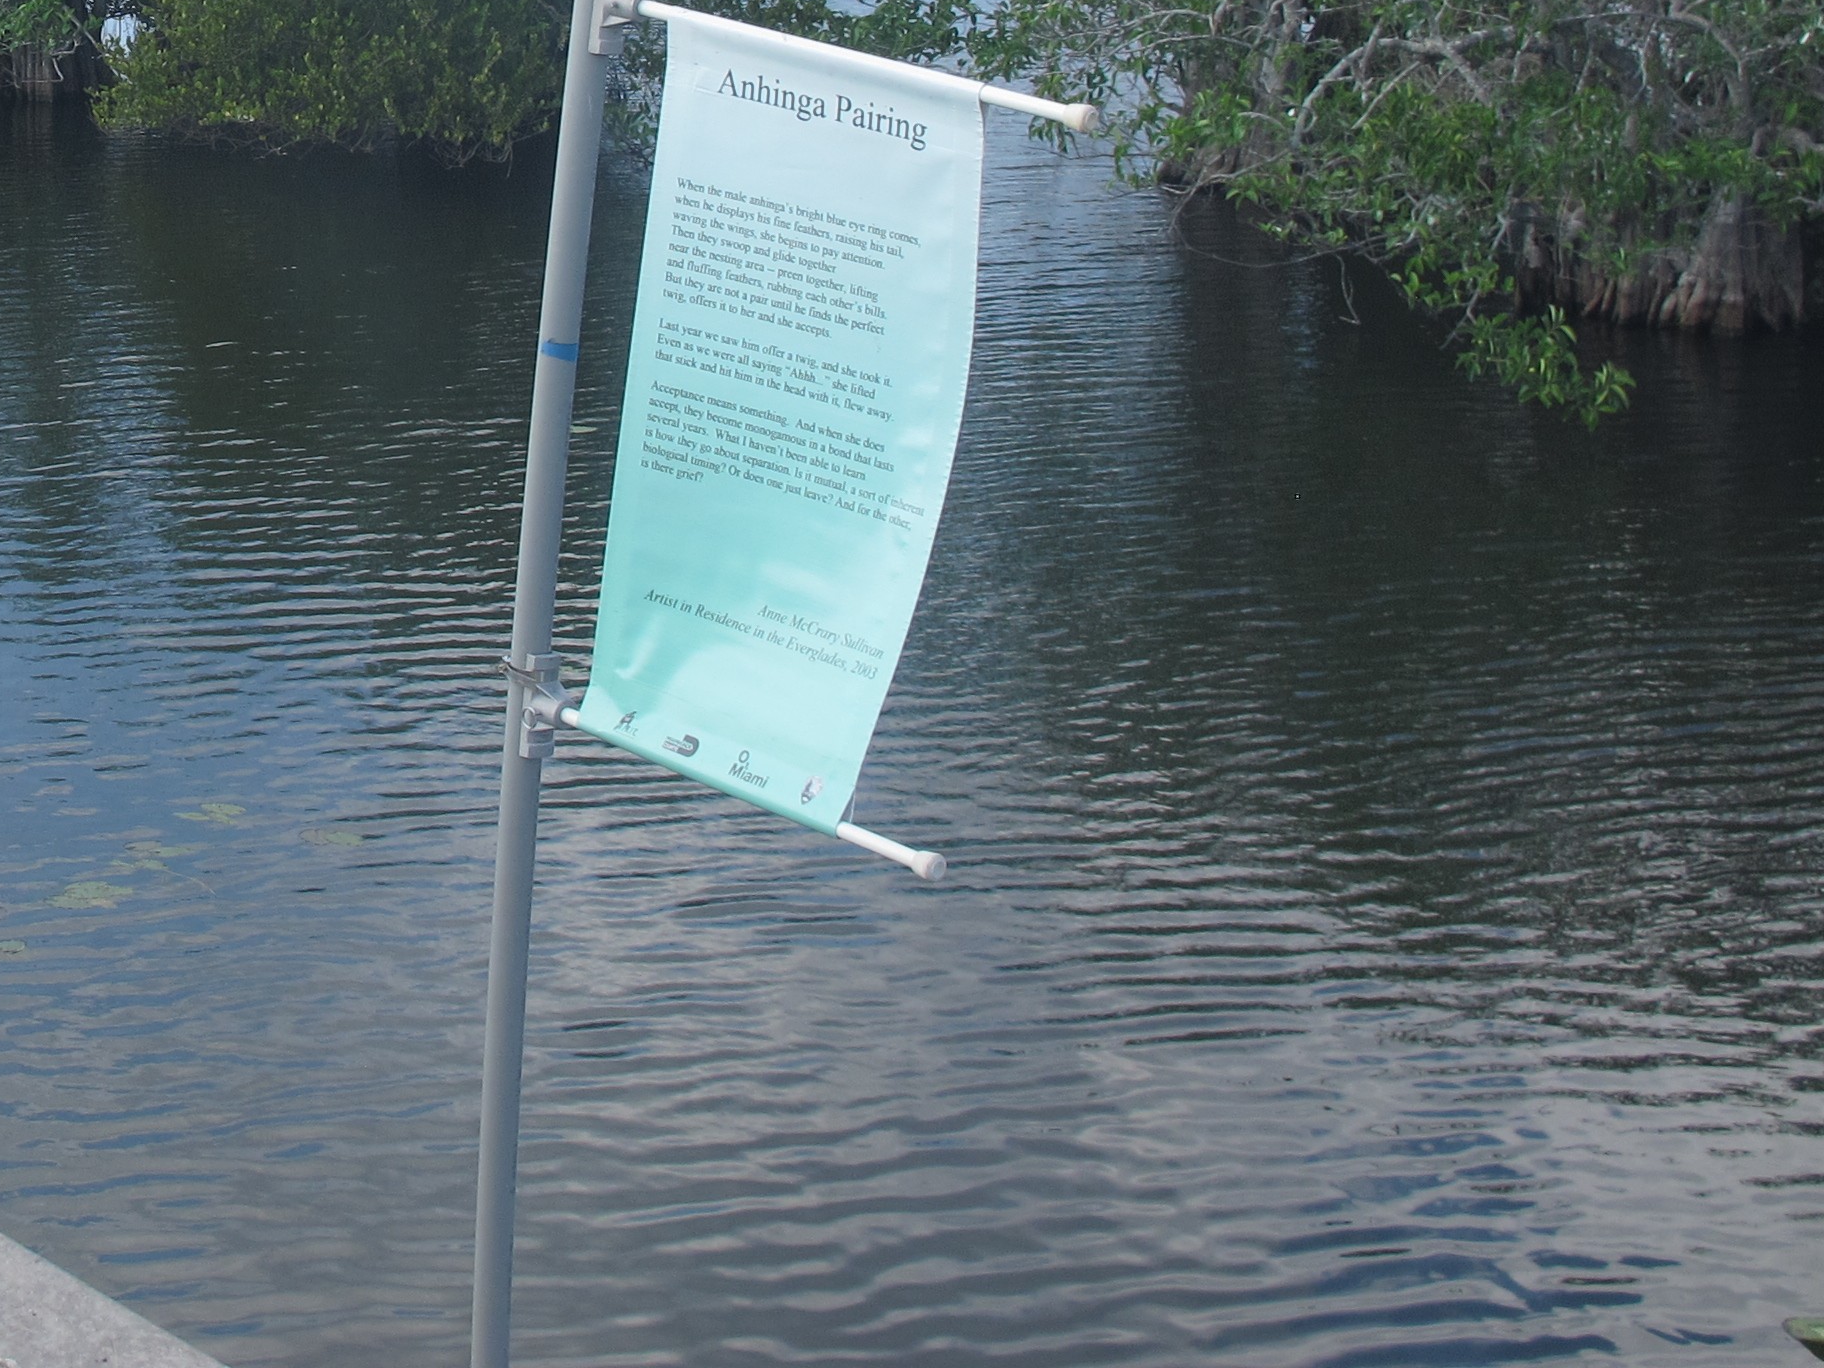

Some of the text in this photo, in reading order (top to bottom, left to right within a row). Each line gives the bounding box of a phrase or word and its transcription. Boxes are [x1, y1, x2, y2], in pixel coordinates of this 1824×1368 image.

[717, 69, 928, 151] Anhinga Pairing
[672, 213, 707, 228] waving
[710, 218, 725, 230] the
[760, 231, 776, 242] she
[778, 234, 808, 250] begins
[810, 243, 820, 253] to
[822, 248, 840, 259] pay
[674, 195, 700, 208] when
[703, 200, 714, 211] he
[716, 204, 754, 221] displays
[757, 212, 771, 224] his
[773, 217, 791, 229] fine
[835, 234, 867, 250] raising
[870, 240, 884, 251] his
[677, 178, 705, 192] When
[708, 185, 722, 197] the
[724, 192, 747, 202] male
[796, 206, 824, 221] bright
[826, 213, 846, 226] blue
[848, 222, 865, 232] eye
[868, 224, 886, 239] ring
[668, 244, 690, 253] near
[692, 246, 707, 258] the
[709, 253, 743, 268] nesting
[745, 261, 764, 271] area
[778, 269, 803, 281] preen
[850, 284, 879, 302] lifting
[671, 225, 838, 272] Then they swoop and glide together
[664, 272, 885, 334] But they are not pair until he finds the perfect
[666, 259, 684, 268] and
[687, 261, 722, 280] fluffing
[767, 283, 803, 300] rubbing
[805, 293, 827, 304] each
[689, 295, 717, 308] offers
[729, 304, 738, 313] to
[740, 306, 756, 317] her
[758, 313, 775, 323] and
[777, 316, 793, 327] she
[655, 349, 673, 361] that
[675, 356, 697, 367] stick
[700, 363, 717, 372] and
[719, 365, 732, 376] hit
[734, 369, 752, 382] him
[767, 378, 781, 389] the
[784, 382, 806, 396] head
[808, 391, 829, 403] with
[844, 399, 864, 412] flew
[657, 334, 876, 398] Even as we were all saying she lifted
[658, 318, 679, 332] Last
[682, 327, 702, 337] year
[704, 332, 719, 341] we
[721, 337, 740, 346] saw
[741, 339, 760, 352] him
[762, 346, 785, 358] offer
[821, 362, 839, 373] and
[841, 366, 857, 377] she
[860, 372, 880, 383] took
[646, 414, 680, 427] several
[716, 429, 740, 444] What
[786, 448, 807, 463] been
[809, 457, 829, 469] able
[831, 463, 840, 473] to
[842, 465, 866, 480] learn
[650, 382, 705, 402] Acceptance
[707, 398, 737, 410] means
[795, 420, 816, 432] And
[818, 427, 842, 440] when
[845, 434, 861, 445] she
[863, 438, 885, 452] does
[684, 406, 704, 420] they
[706, 411, 743, 428] become
[744, 425, 806, 446] monogamous
[828, 444, 852, 459] bond
[854, 452, 871, 465] that
[874, 457, 895, 471] lasts
[642, 442, 887, 520] biological timing? Or does one just leave? And for the
[651, 460, 704, 481] there grief?
[655, 428, 675, 442] how
[677, 436, 698, 450] they
[700, 444, 712, 453] go
[714, 446, 740, 460] about
[858, 489, 876, 500] sort
[644, 589, 878, 680] Artist in Residence in the Everglades, 2003
[757, 605, 884, 659] Anne McCrary Sullivan
[728, 762, 770, 788] Miami
